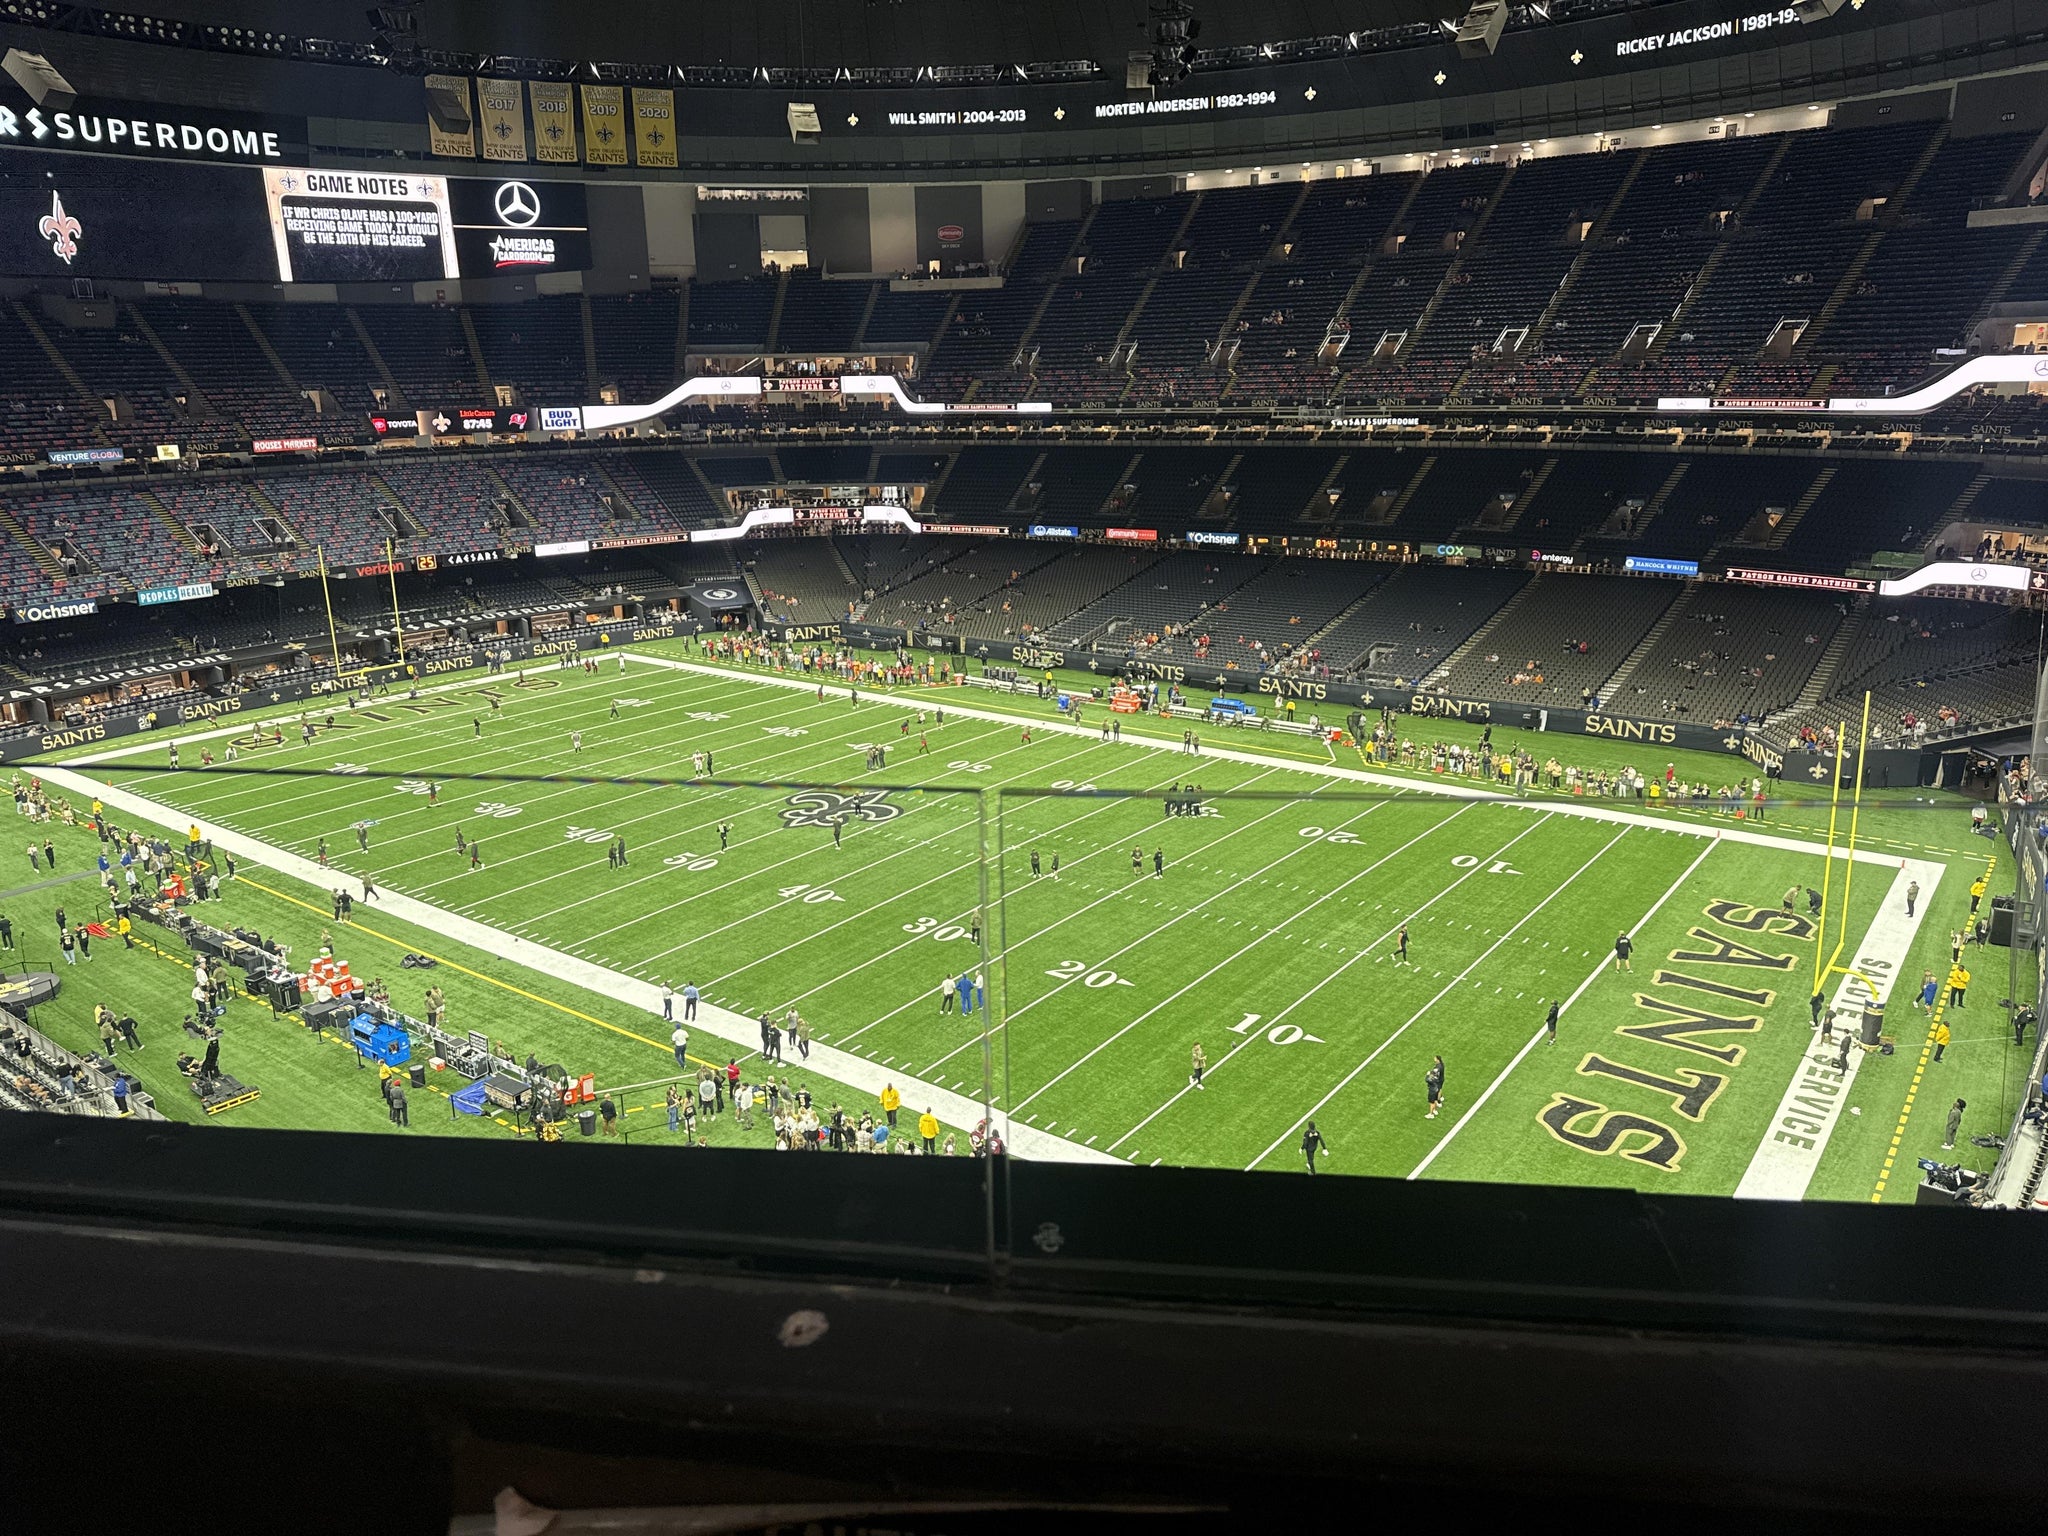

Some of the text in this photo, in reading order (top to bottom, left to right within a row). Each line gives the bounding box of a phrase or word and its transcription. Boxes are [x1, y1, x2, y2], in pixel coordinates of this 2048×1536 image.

[1616, 35, 1666, 56] RICKEY
[1667, 21, 1732, 48] JACKSON
[487, 98, 516, 112] 2017
[538, 101, 567, 113] 2018
[590, 104, 618, 116] 2019
[1096, 92, 1276, 117] MORTEN ANDERSEN 1982-1994
[639, 107, 669, 119] 2020
[889, 110, 1026, 125] WILL SMITH 2004-2013
[54, 112, 281, 157] SUPERDOME
[434, 144, 473, 155] SAINTS
[486, 149, 524, 160] SAINTS
[539, 150, 575, 160] SAINTS
[589, 153, 625, 163] SAINTS
[640, 155, 675, 165] SAINTS
[307, 174, 408, 196] GAME NOTES
[283, 206, 438, 224] IF WR CHRIS OLAVE HAS A 100-YARD
[287, 218, 438, 236] RECEIVING GAME TODAY, IT WOULD
[304, 232, 426, 247] BE THE 10TH OF HIS CAREER.
[1376, 398, 1406, 406] SAINTS
[1442, 397, 1473, 405] SAINTS
[1510, 397, 1543, 405] SAINTS
[1583, 398, 1617, 406] SAINTS
[549, 410, 573, 419] BUD
[1372, 417, 1420, 425] SUPERDOME
[387, 420, 418, 429] TOYOTA
[545, 418, 578, 428] LIGHT
[1574, 418, 1606, 427] SAINTS
[1644, 419, 1677, 427] SAINTS
[1718, 420, 1753, 428] SAINTS
[1797, 421, 1835, 430] SAINTS
[1881, 423, 1921, 432] SAINTS
[1971, 425, 2011, 434] SAINTS
[254, 439, 317, 450] ROUSES MARKETS
[324, 436, 354, 445] SAINTS
[186, 443, 219, 452] SAINTS
[0, 453, 36, 464] SAINTS
[50, 450, 123, 463] VENTURE GLOBAL
[1046, 527, 1073, 536] Allstate
[1194, 532, 1238, 544] Ochsner
[504, 545, 532, 555] SAINTS
[1437, 545, 1464, 555] COX
[1486, 547, 1516, 557] SAINTS
[419, 557, 435, 568] 25
[448, 551, 499, 564] CAESARS
[1541, 554, 1573, 564] entergy
[356, 562, 405, 577] verizon
[1635, 561, 1698, 572] HANCOCK WHITNEY
[298, 568, 330, 579] SAINTS
[1741, 571, 1858, 589] PATRON SAINTS PARTNERS
[226, 577, 260, 588] SAINTS
[141, 585, 211, 603] PEOPLES HEALTH
[27, 602, 96, 622] Ochsner
[469, 601, 589, 621] SUPERDOME
[633, 625, 674, 641] SAINTS
[785, 624, 841, 641] SAINTS
[533, 639, 578, 656] SAINTS
[1012, 646, 1064, 666] SAIS
[74, 653, 233, 686] SUPERDOME
[426, 656, 473, 673] SAINTS
[311, 676, 363, 695] SAINTS
[184, 697, 242, 720] SAINTS
[1585, 714, 1676, 744] SAINTS
[41, 724, 106, 750] SAINTS
[1742, 736, 1783, 768] SAINTS
[947, 760, 993, 773] 50
[478, 802, 523, 818] 30
[565, 825, 616, 843] 40
[1298, 826, 1356, 845] 20
[663, 852, 719, 872] 50
[1451, 855, 1508, 874] 10
[778, 884, 836, 904] 40
[902, 917, 967, 942] 30
[1044, 960, 1118, 988] 20
[1226, 1012, 1304, 1045] 10
[1535, 897, 1822, 1173] SAINTS
[1774, 1052, 1850, 1151] SERVICE
